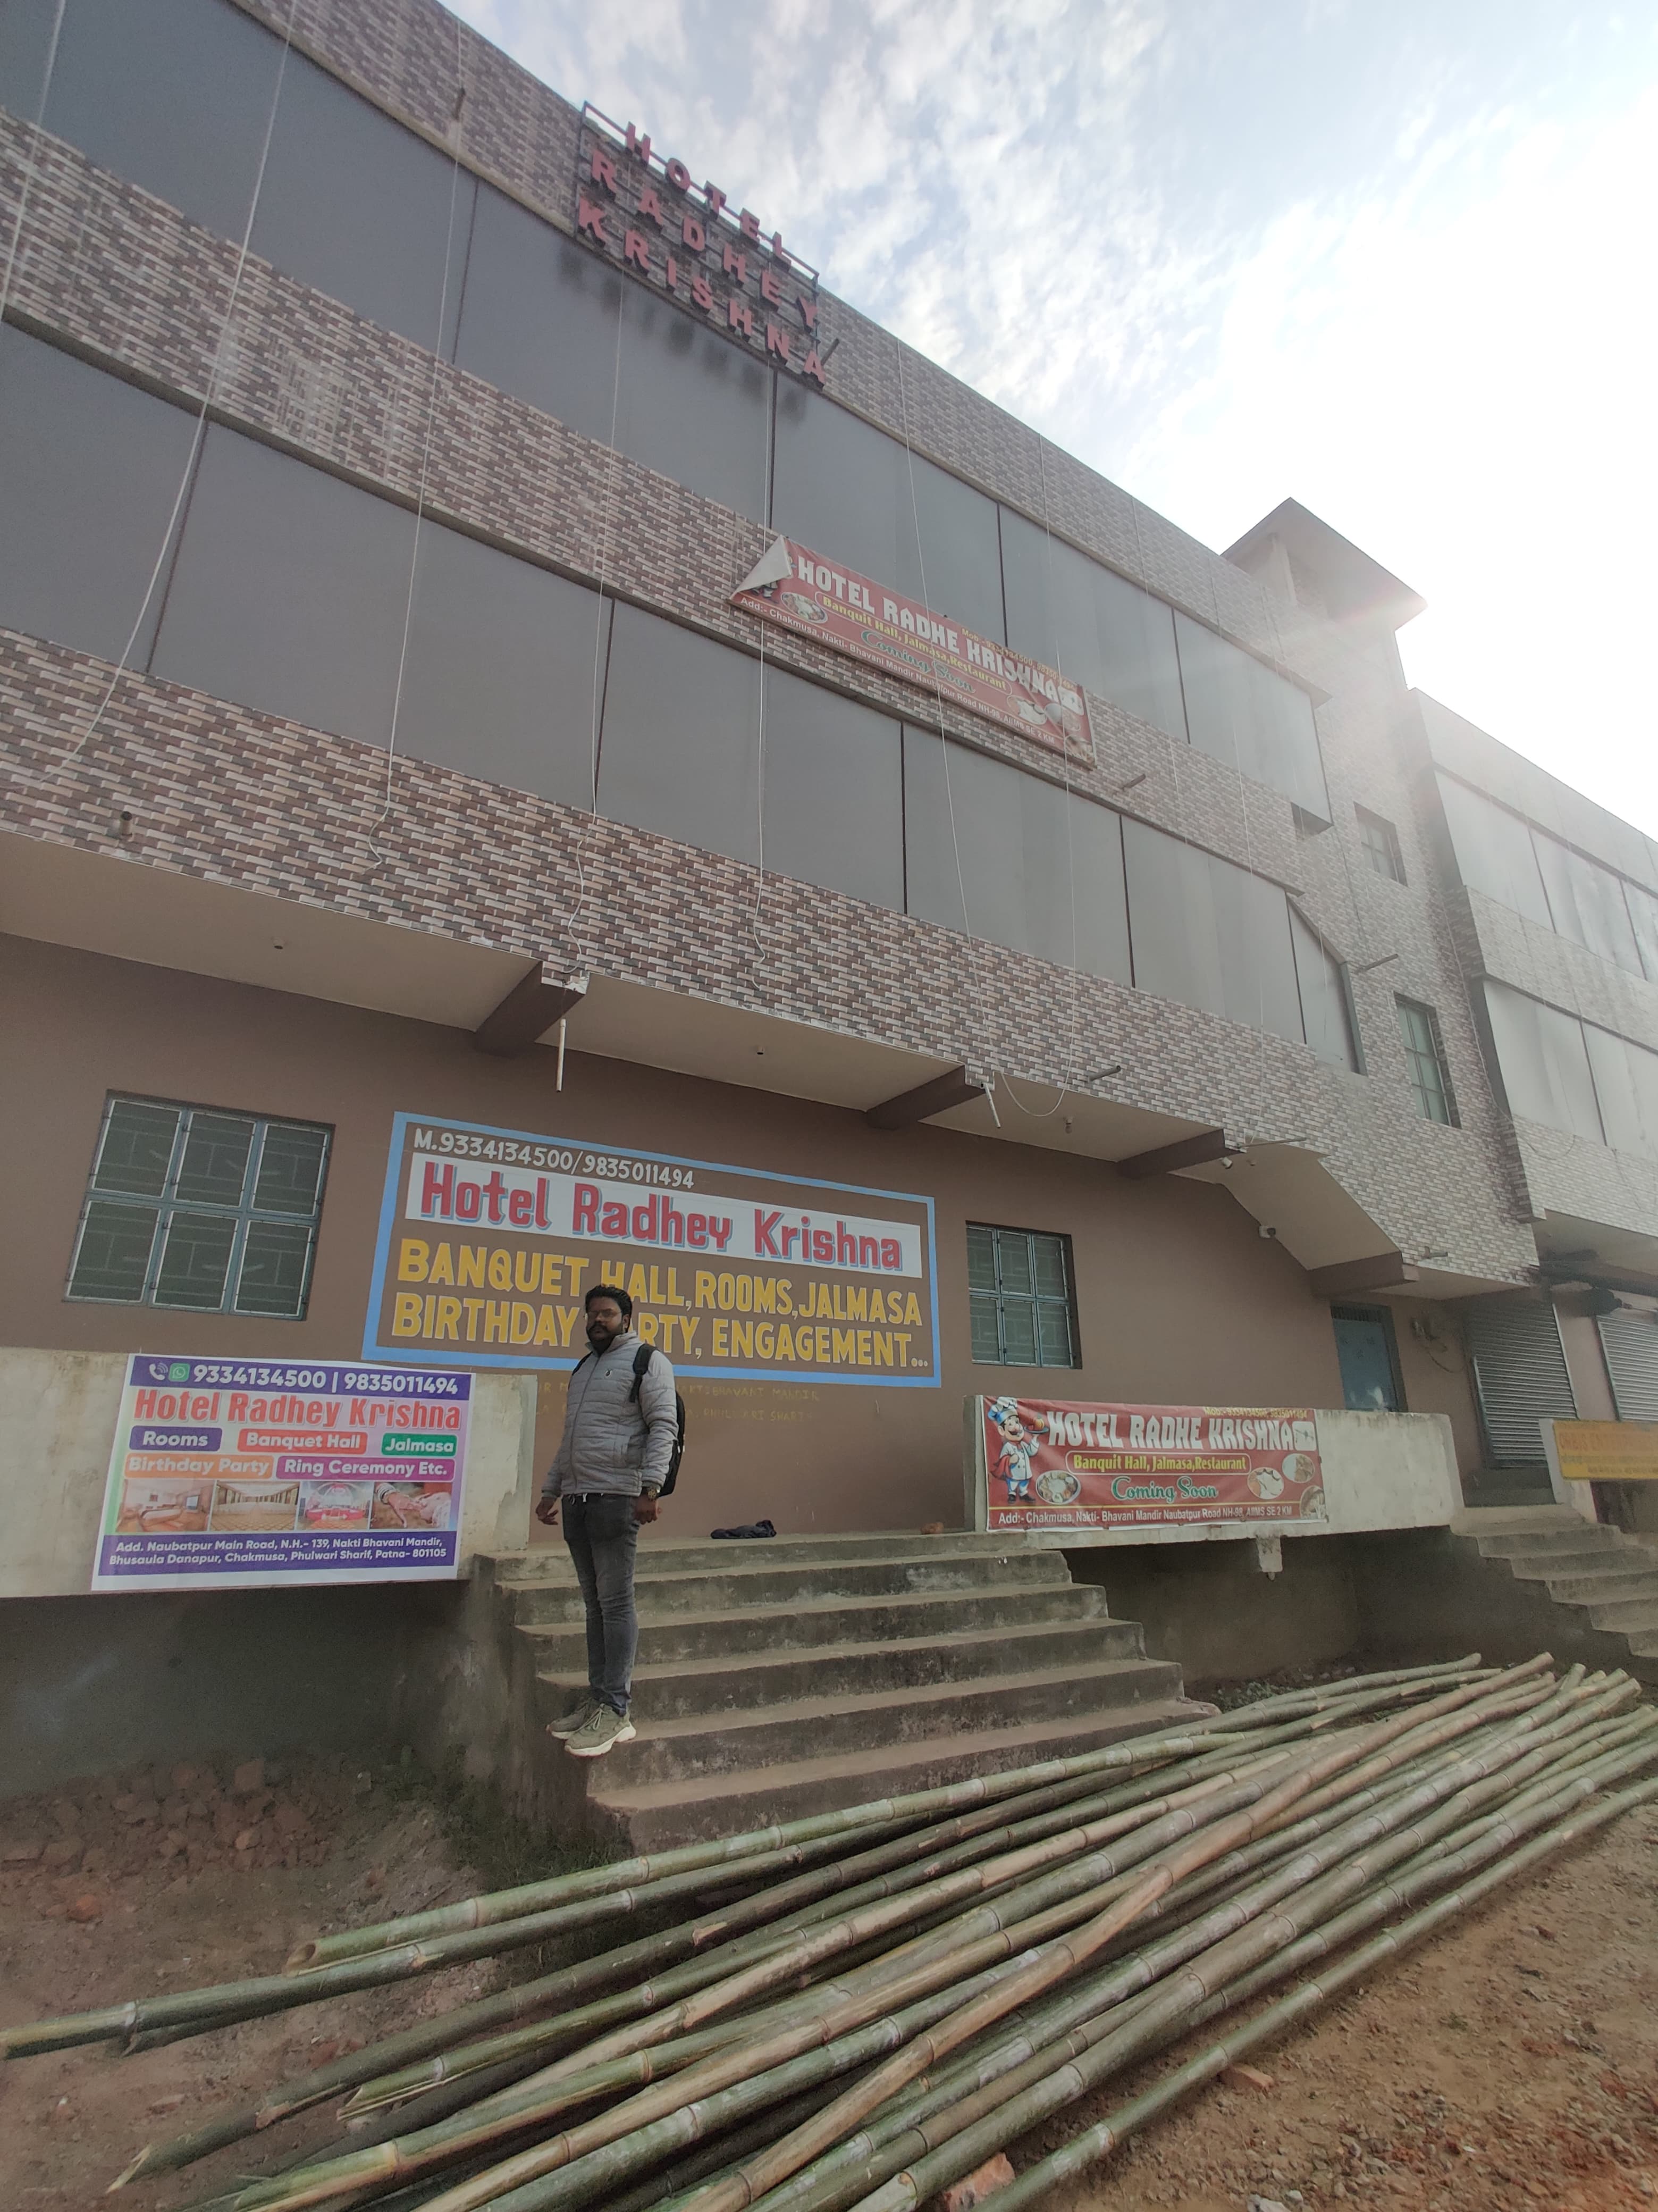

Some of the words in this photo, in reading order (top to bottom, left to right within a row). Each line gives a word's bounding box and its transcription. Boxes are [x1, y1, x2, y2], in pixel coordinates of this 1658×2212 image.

[626, 121, 792, 272] HOTEL
[590, 149, 817, 328] RADHEY
[578, 197, 826, 388] KRISHNA
[798, 556, 874, 615] HOTEL
[883, 596, 960, 655] RADHE
[966, 639, 1058, 703] KRISHNA
[823, 596, 872, 626] Banquit
[876, 621, 902, 641] Hall,
[770, 609, 819, 638] Chakmusa,
[850, 644, 883, 664] Bhavani
[886, 660, 914, 678] Mandir
[957, 693, 977, 708] Road
[1042, 732, 1055, 744] KM
[861, 630, 931, 673] Coming
[931, 660, 976, 693] Soon
[421, 1161, 552, 1230] Hotel
[573, 1183, 733, 1252] Radhey
[754, 1209, 903, 1271] Krishna
[398, 1238, 589, 1297] BANQUET
[391, 1292, 580, 1347] BIRTHDAY
[194, 1364, 326, 1388] 9334134500
[344, 1373, 458, 1394] 9835011494
[134, 1389, 221, 1422] Hotel
[228, 1392, 342, 1428] Radhey
[349, 1398, 460, 1430] Krishna
[142, 1431, 208, 1446] Rooms
[247, 1432, 322, 1449] Banquet
[327, 1435, 360, 1449] Hall
[384, 1438, 454, 1453] Jalmasa
[1047, 1411, 1124, 1448] HOTEL
[1130, 1415, 1203, 1449] RADHE
[1208, 1418, 1294, 1451] KRISHNA
[128, 1457, 214, 1475] Birthday
[218, 1459, 269, 1476] Party
[284, 1459, 324, 1477] Ring
[329, 1460, 416, 1478] Ceremony
[418, 1462, 448, 1476] Etc.
[1073, 1454, 1122, 1472] Banquit
[1125, 1455, 1150, 1472] Hall,
[1111, 1476, 1176, 1504] Coming
[1176, 1476, 1218, 1499] Soon
[999, 1512, 1024, 1524] Add:-
[1026, 1512, 1074, 1524] Chakmusa,
[1101, 1510, 1134, 1522] Bhavani
[1136, 1510, 1162, 1521] Mandir
[1164, 1509, 1200, 1521] Naubatpur
[1201, 1508, 1221, 1518] Road
[1266, 1506, 1275, 1516] SE
[1276, 1506, 1281, 1515] 2
[1282, 1505, 1292, 1515] KM
[110, 1555, 164, 1565] Bhusaula
[167, 1554, 222, 1565] Danapur,
[224, 1552, 288, 1562] Chakmusa,
[290, 1551, 338, 1561] Phulwari
[340, 1550, 373, 1560] Sharif,
[375, 1549, 410, 1559] Patna-
[412, 1548, 447, 1558] 801105
[116, 1541, 144, 1552] Add.
[147, 1541, 212, 1552] Naubatpur
[215, 1540, 243, 1550] Main
[246, 1539, 278, 1551] Road,
[281, 1539, 308, 1549] N.H.-
[312, 1539, 330, 1549] 139,
[333, 1538, 360, 1548] Nakti
[363, 1538, 404, 1547] Bhavani
[406, 1537, 443, 1547] Mandir,
